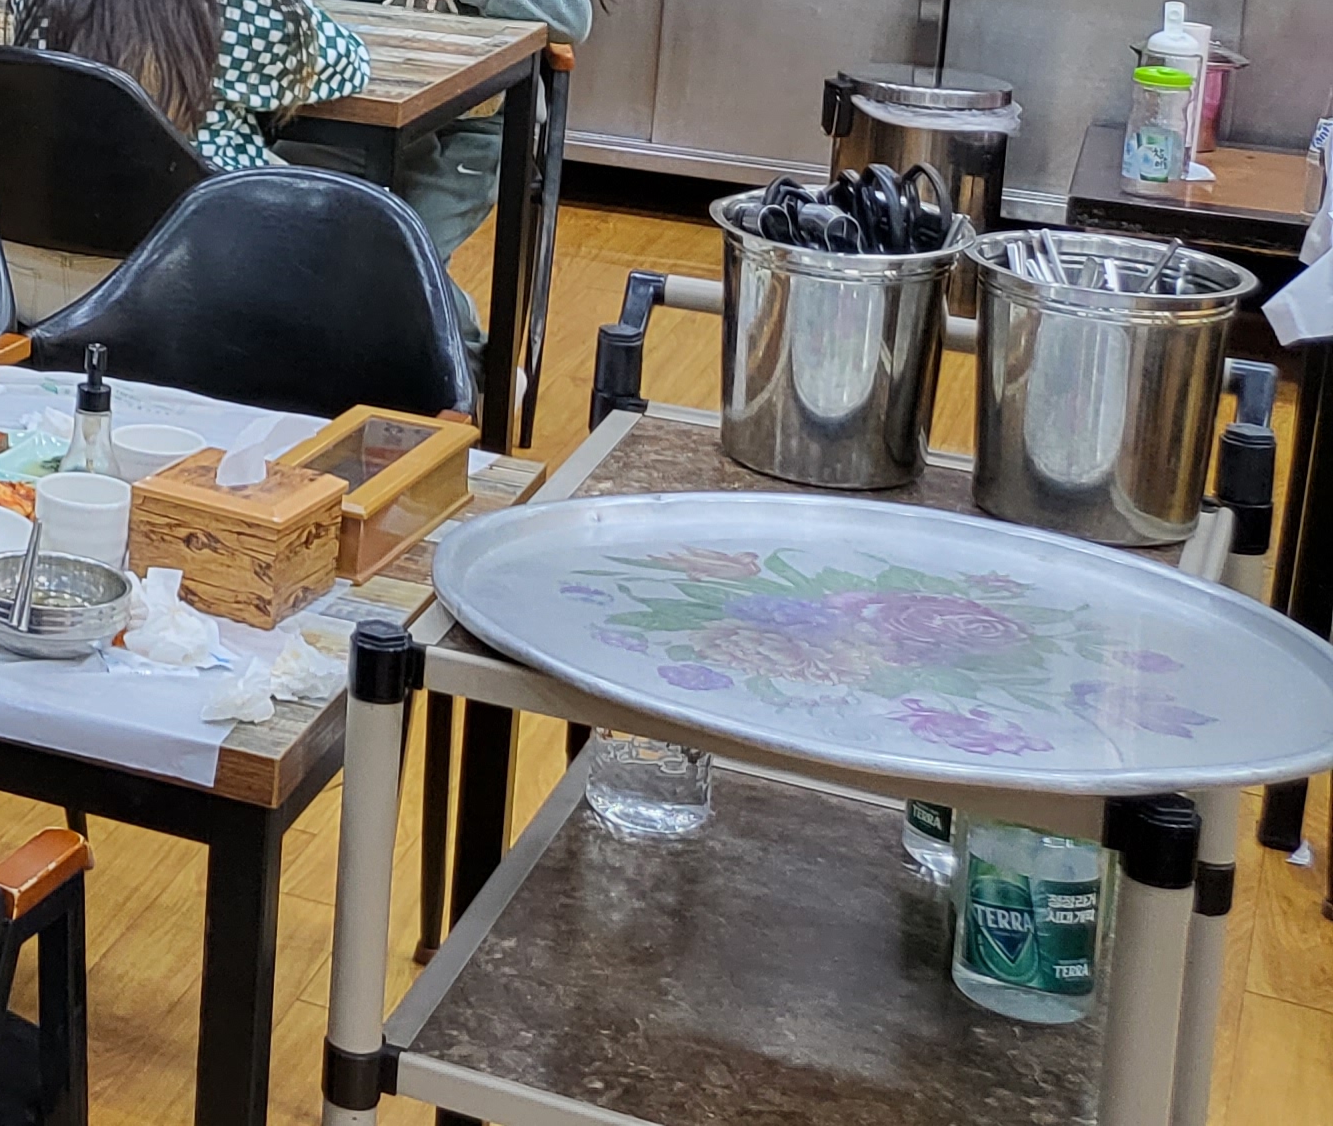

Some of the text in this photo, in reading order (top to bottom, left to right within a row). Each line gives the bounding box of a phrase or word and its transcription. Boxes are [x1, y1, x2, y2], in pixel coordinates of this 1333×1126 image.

[912, 804, 943, 831] TERRA
[973, 903, 1034, 933] TERRA
[1053, 962, 1089, 979] TERRA
